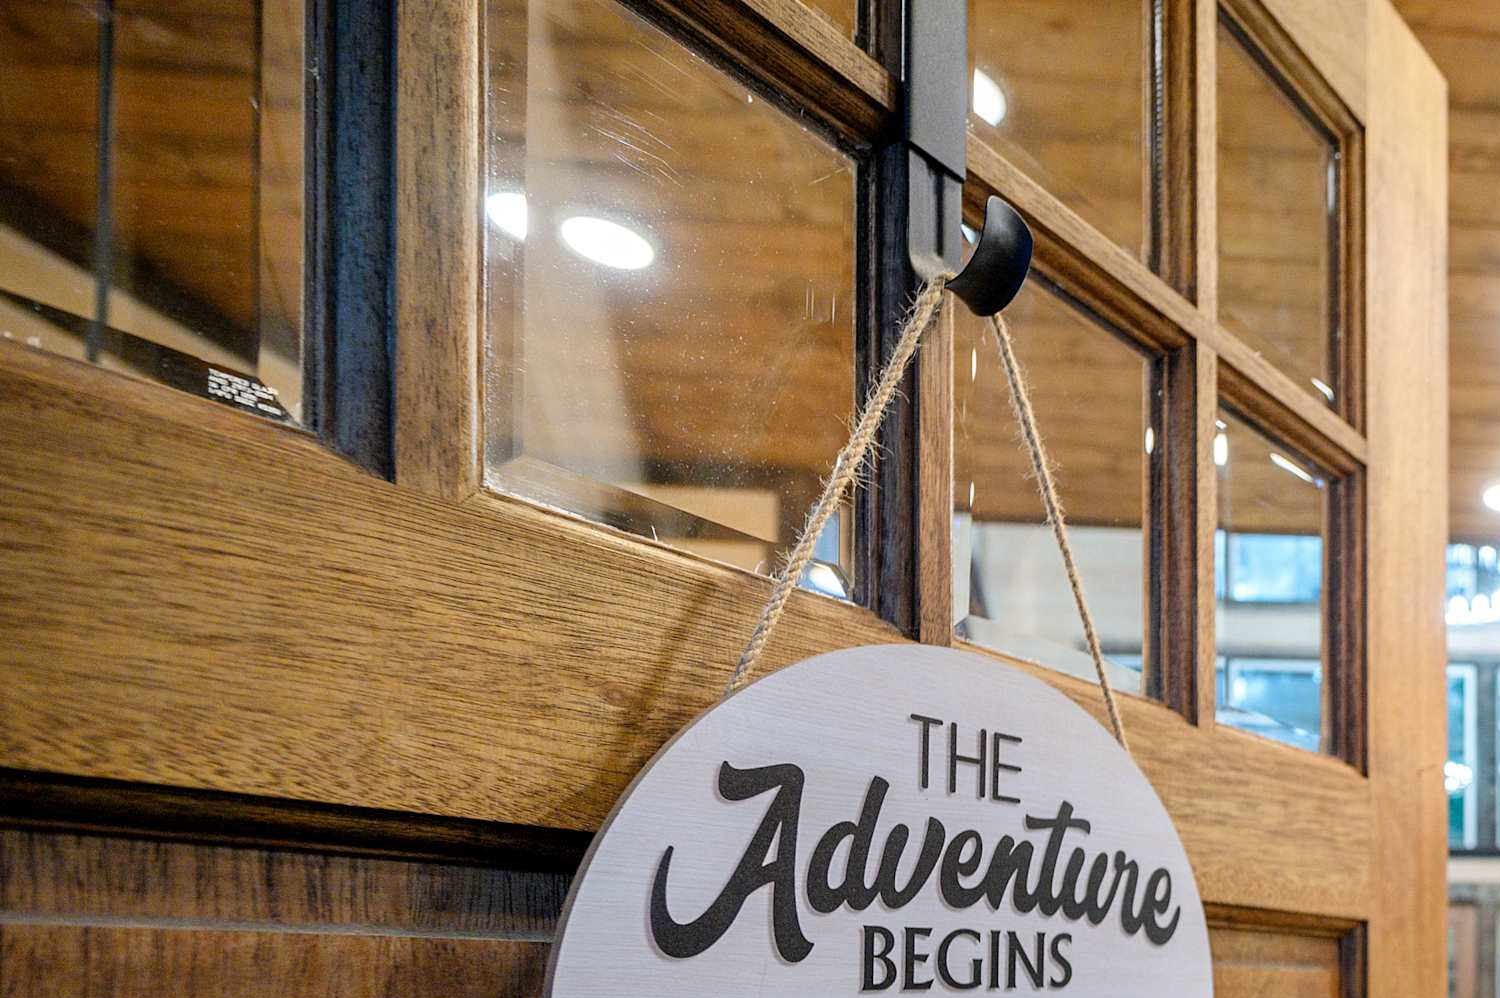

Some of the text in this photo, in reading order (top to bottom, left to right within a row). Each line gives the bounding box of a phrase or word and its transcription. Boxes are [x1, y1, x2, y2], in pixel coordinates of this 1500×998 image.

[909, 713, 1023, 804] THE
[649, 760, 1182, 964] Adventure
[860, 924, 1073, 992] BEGINS
